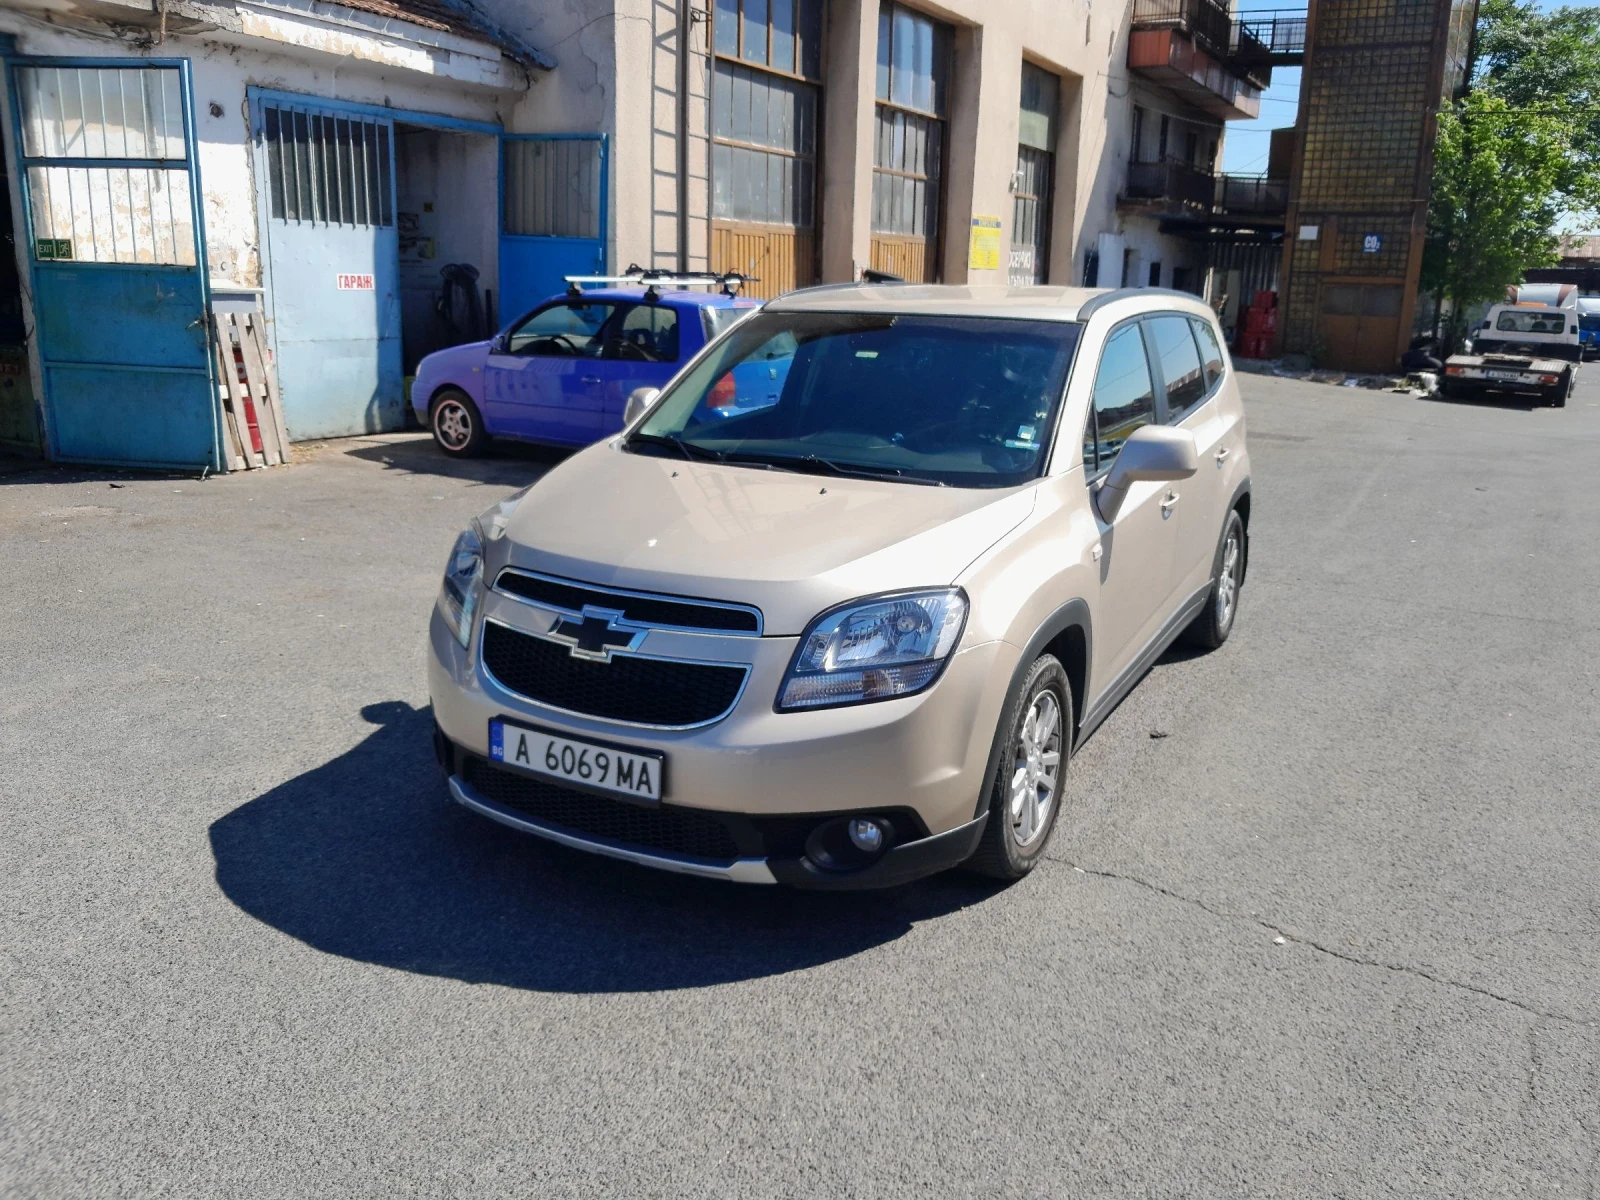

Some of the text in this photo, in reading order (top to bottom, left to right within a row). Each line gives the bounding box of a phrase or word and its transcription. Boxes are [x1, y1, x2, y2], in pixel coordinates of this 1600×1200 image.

[38, 244, 53, 253] EXIT
[338, 275, 373, 289] ГАРАЖ
[492, 745, 503, 756] BG
[515, 733, 653, 795] A 6069 MA
